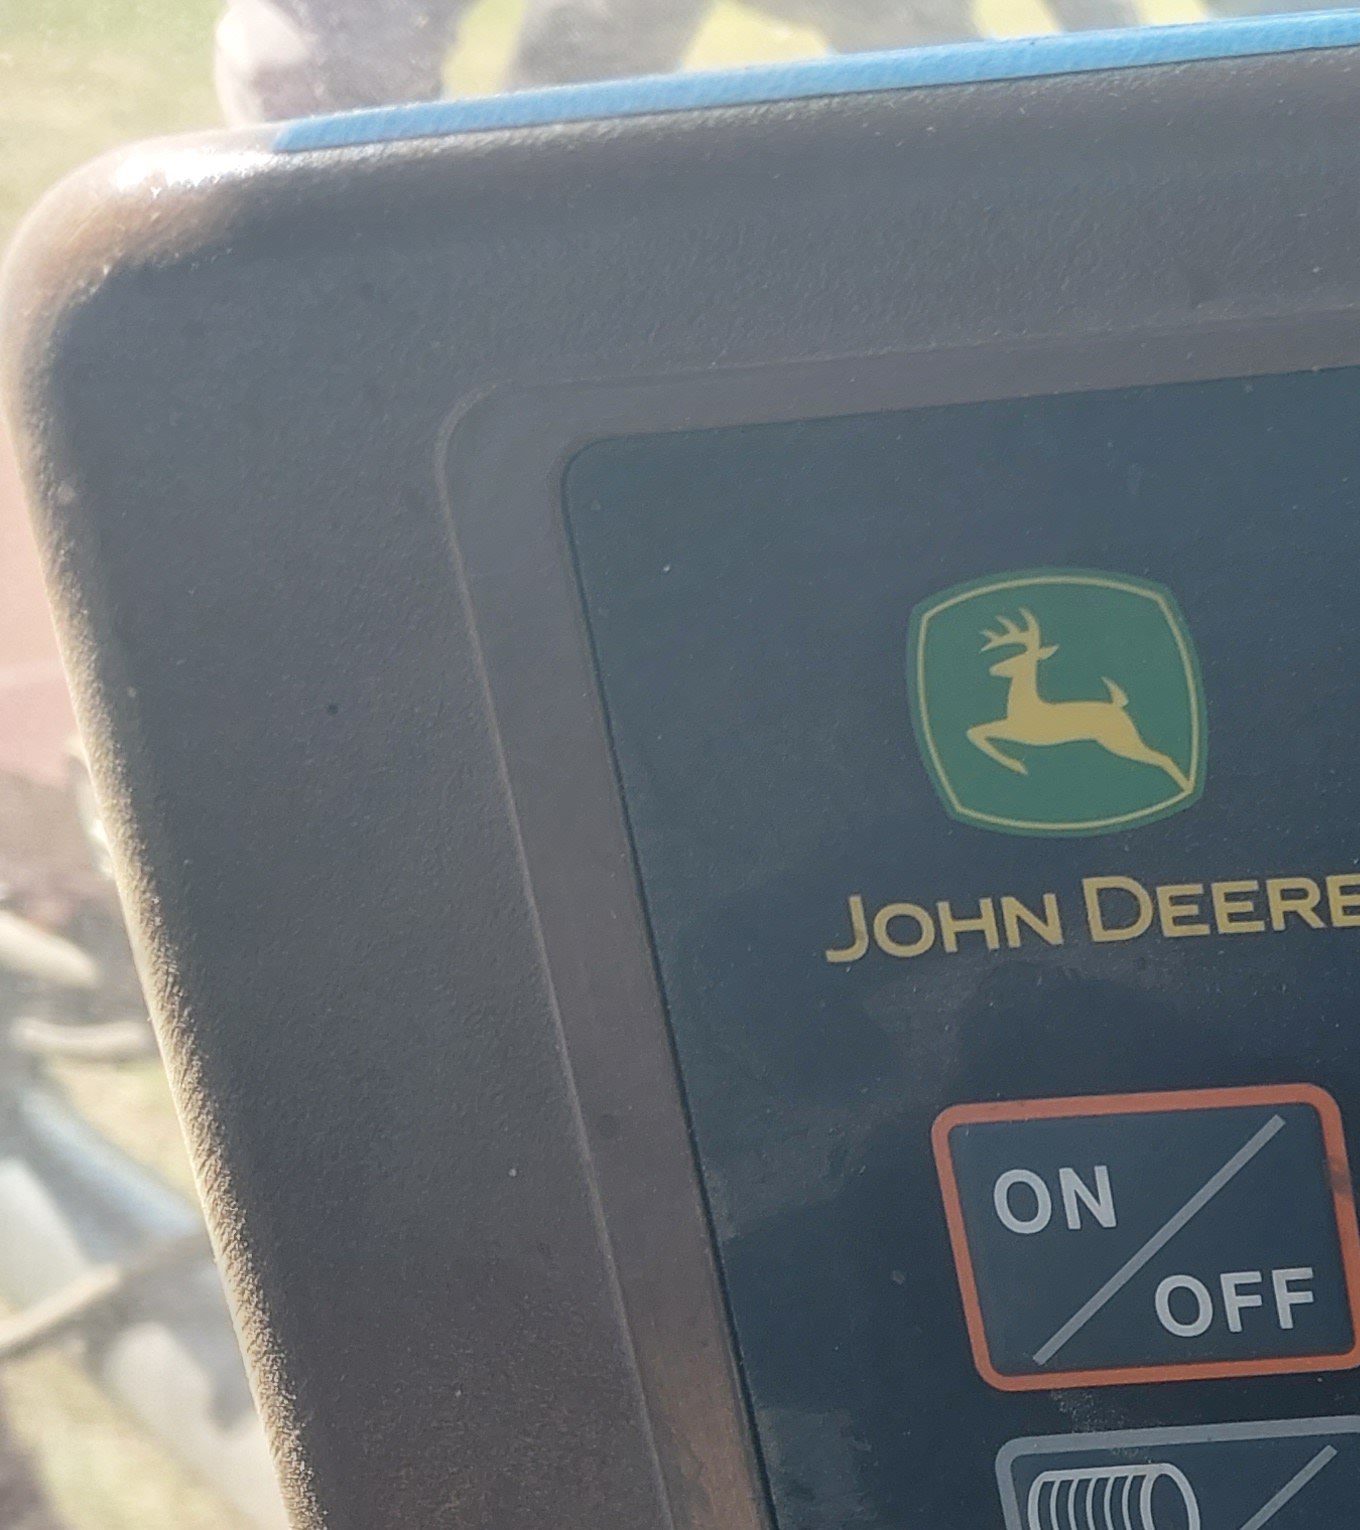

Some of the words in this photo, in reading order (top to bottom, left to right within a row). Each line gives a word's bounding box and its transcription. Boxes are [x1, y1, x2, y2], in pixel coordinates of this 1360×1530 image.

[825, 893, 1064, 962] JOHN
[993, 1165, 1117, 1235] ON
[1154, 1267, 1314, 1337] OFF
